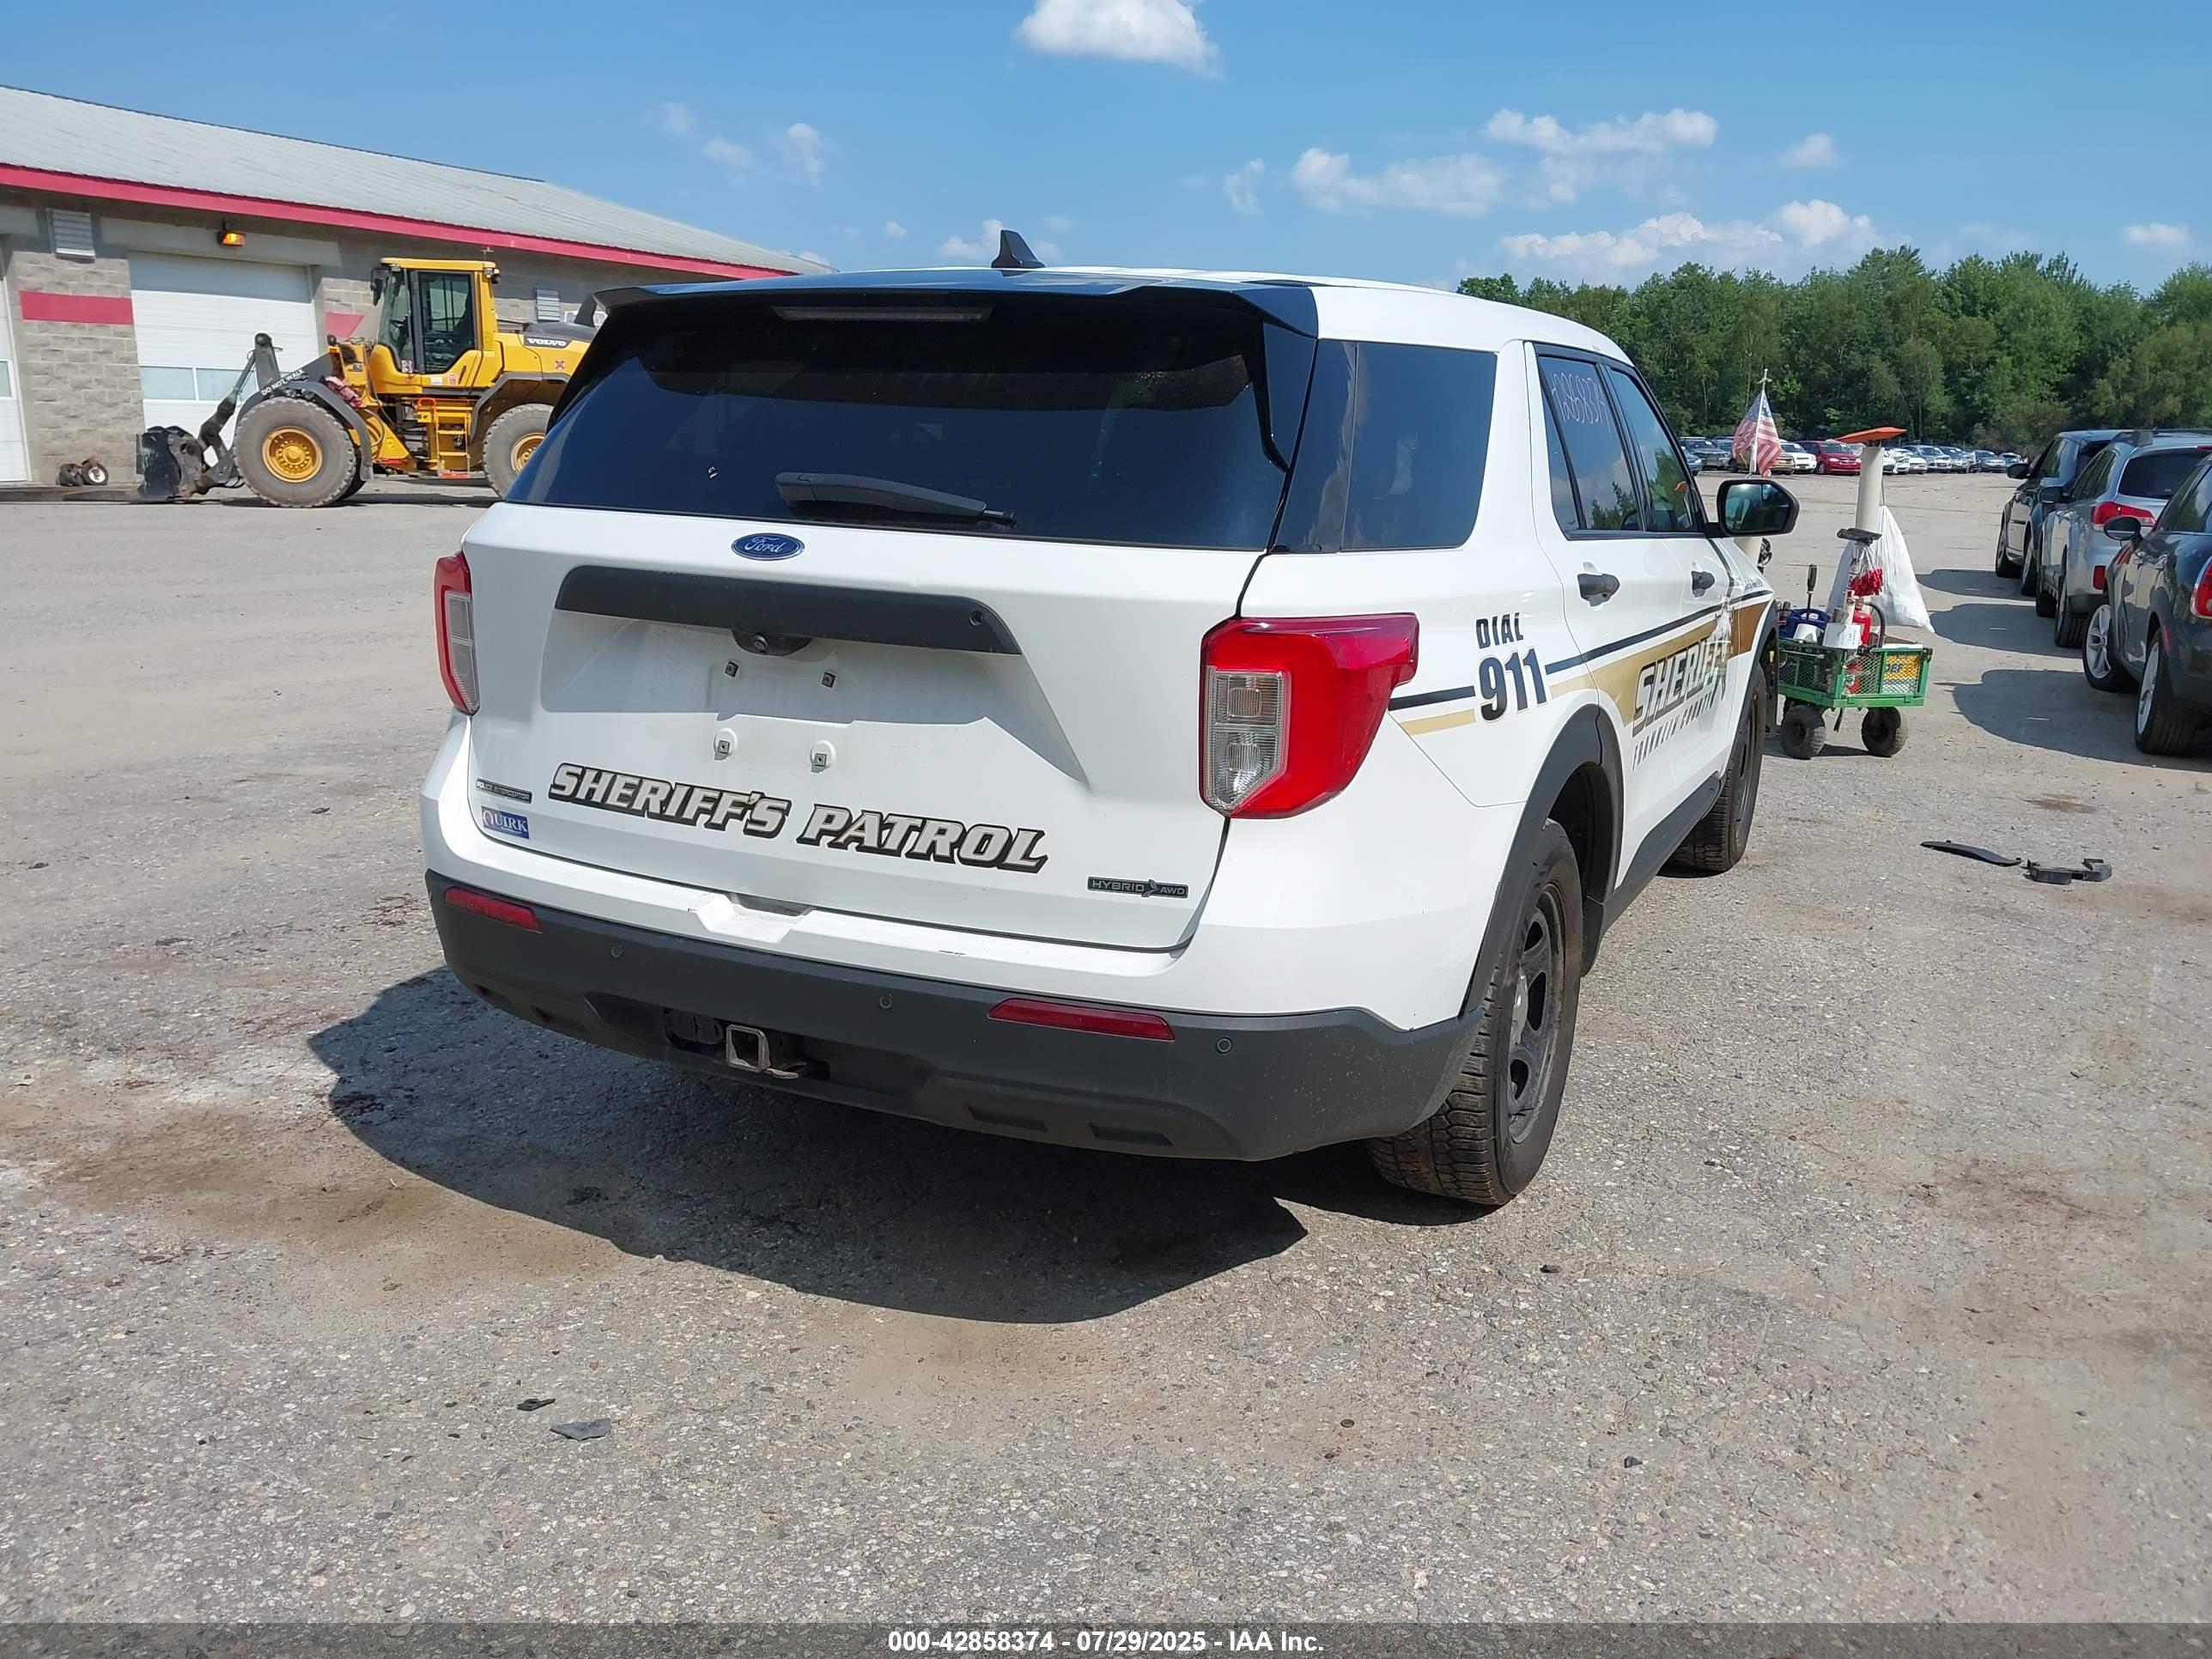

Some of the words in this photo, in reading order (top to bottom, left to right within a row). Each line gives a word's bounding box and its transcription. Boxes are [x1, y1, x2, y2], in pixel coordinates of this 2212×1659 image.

[526, 337, 567, 347] VOLVO
[260, 386, 272, 396] DO
[1476, 612, 1523, 649] DIAL
[1479, 648, 1547, 721] 911
[477, 781, 494, 791] POLICE
[483, 810, 528, 832] QUIRK
[549, 763, 792, 839] SHERIFF'S
[796, 803, 1048, 874] PATROL
[1092, 879, 1145, 892] HYBRID
[1159, 886, 1185, 895] AWD
